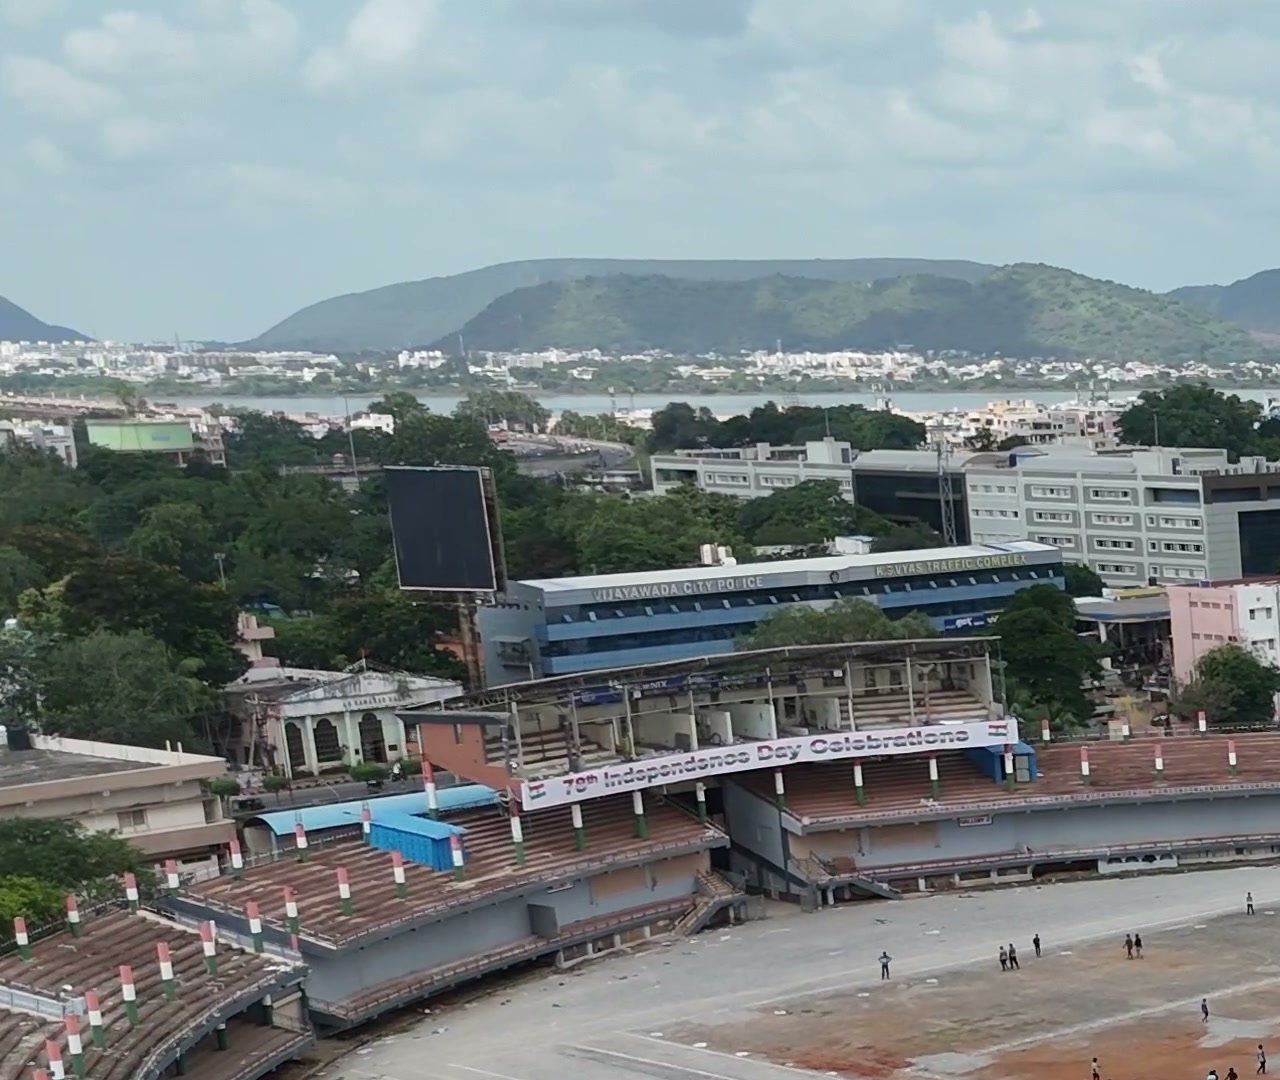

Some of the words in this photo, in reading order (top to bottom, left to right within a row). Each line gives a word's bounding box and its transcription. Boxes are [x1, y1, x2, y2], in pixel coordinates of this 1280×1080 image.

[927, 559, 973, 573] TRAFFIC
[976, 554, 1027, 568] COMPLEX
[592, 583, 678, 600] VIJAYAWADA
[683, 581, 712, 594] CITY
[562, 773, 598, 795] 78th
[603, 749, 751, 787] Independence
[757, 743, 802, 763] Day
[810, 729, 969, 754] Celebrations
